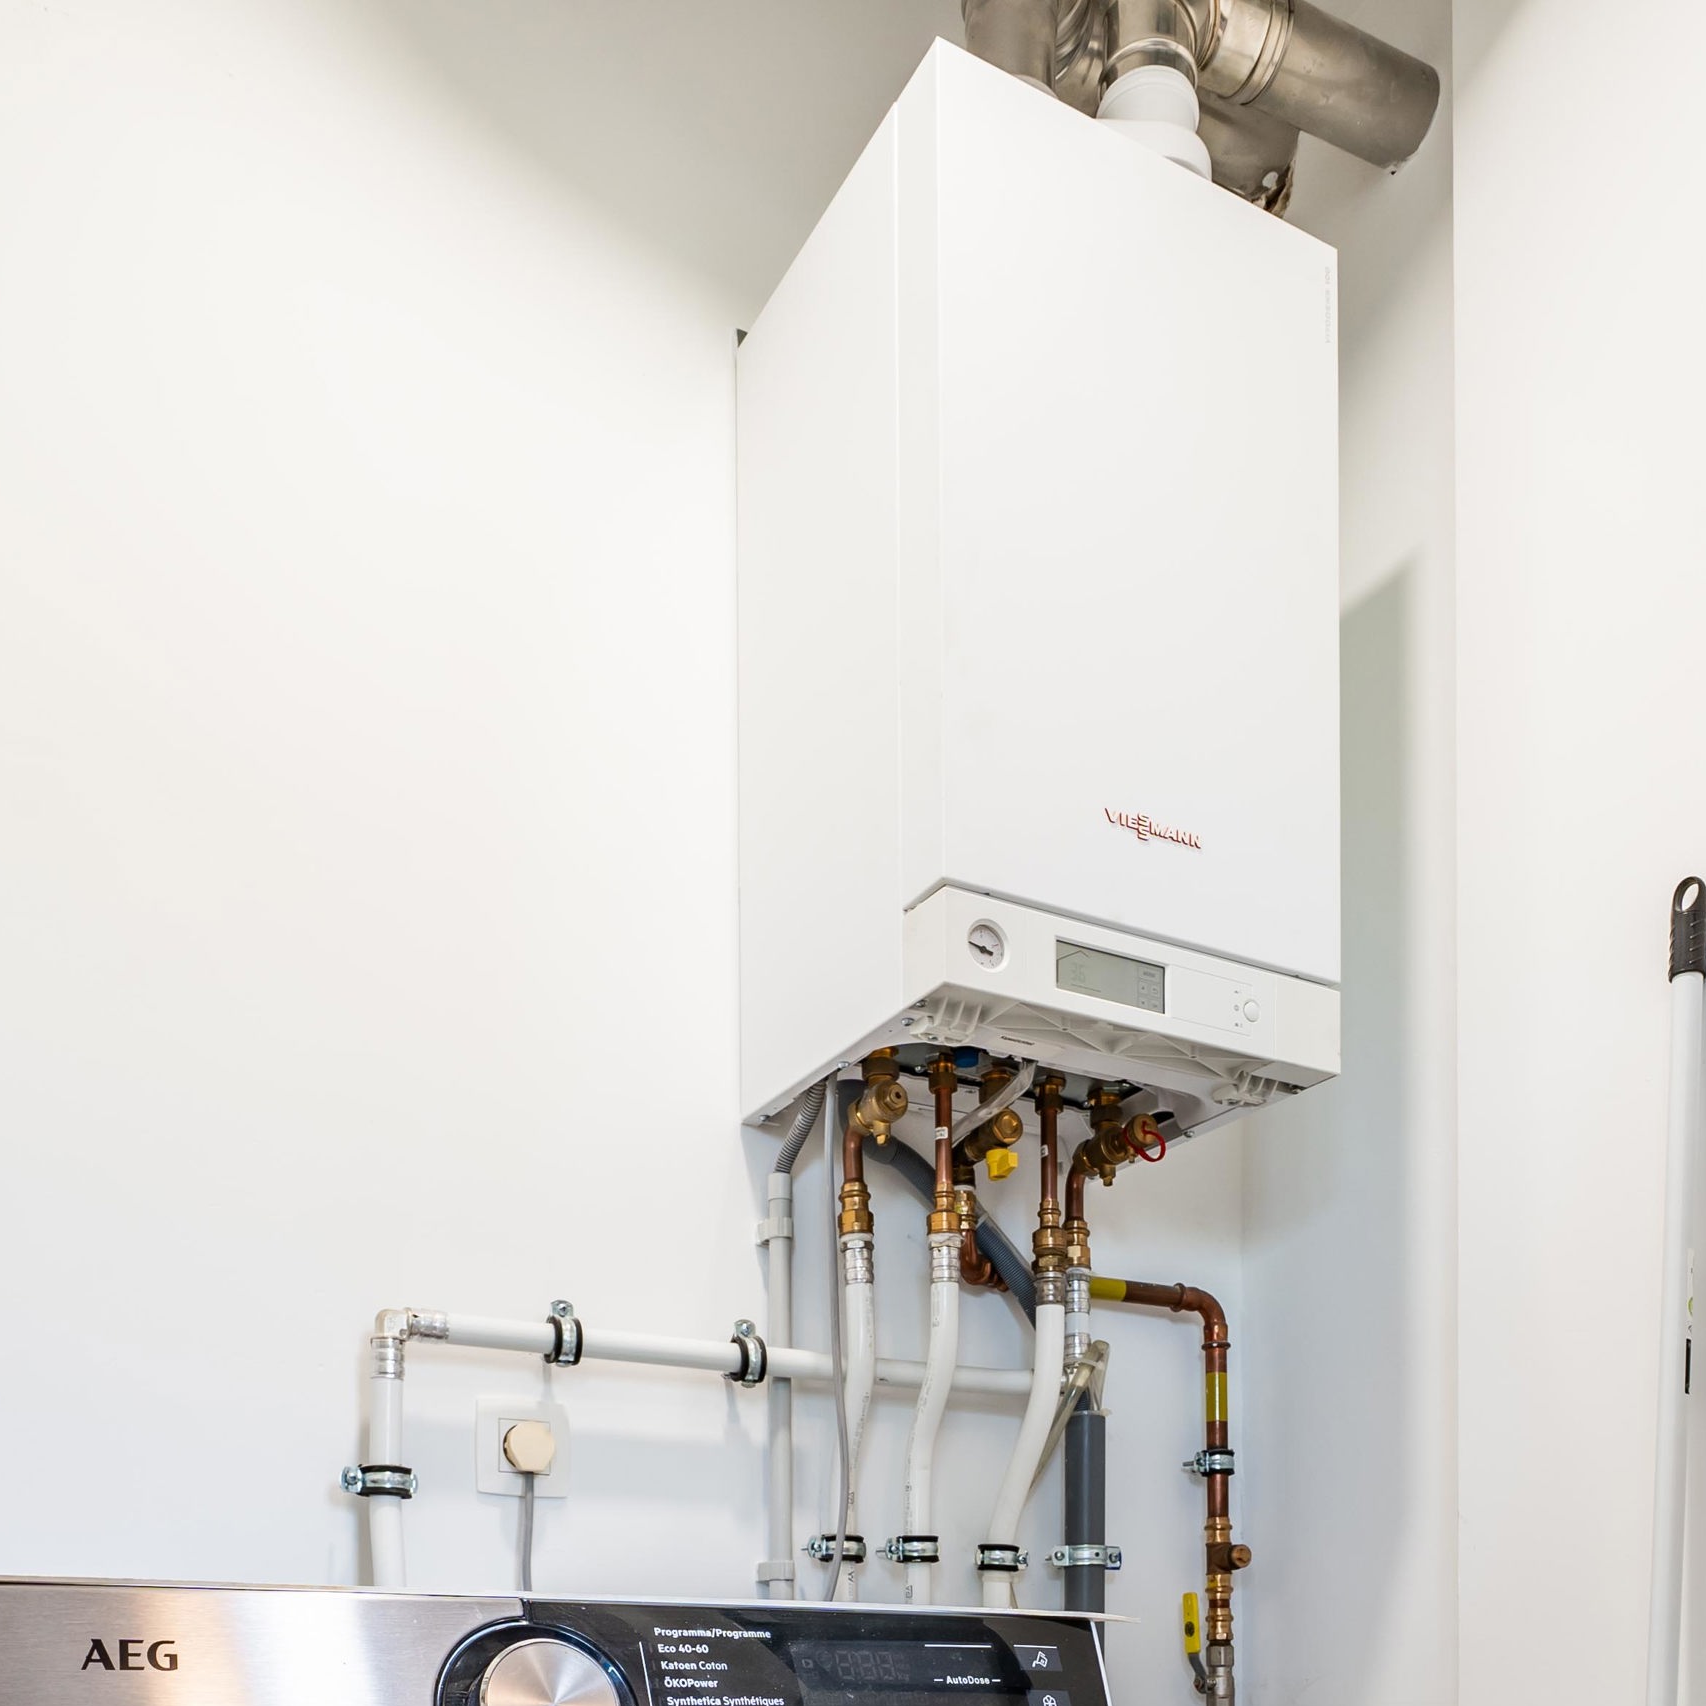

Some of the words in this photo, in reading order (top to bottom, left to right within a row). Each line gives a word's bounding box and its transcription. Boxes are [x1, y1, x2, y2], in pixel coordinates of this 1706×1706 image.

[1104, 807, 1202, 850] VIESSMANN
[653, 1627, 771, 1640] Programma/Programme
[81, 1638, 179, 1672] AEG
[657, 1643, 677, 1654] Eco
[678, 1643, 710, 1654] 40-60
[660, 1660, 697, 1671] Katoen
[698, 1660, 728, 1671] Coton
[663, 1676, 719, 1689] ÖKOPower
[946, 1675, 991, 1685] AutoDose
